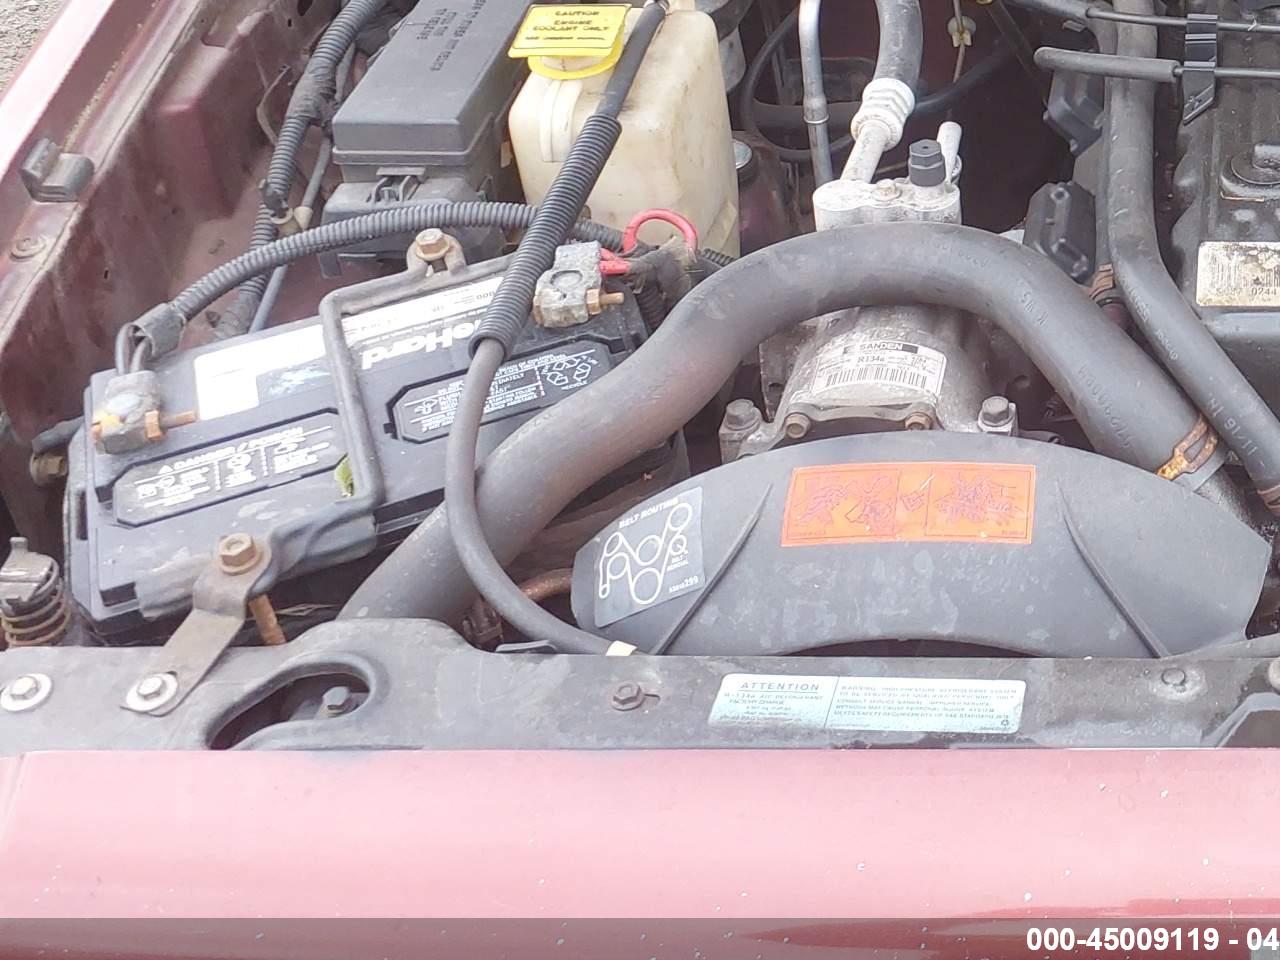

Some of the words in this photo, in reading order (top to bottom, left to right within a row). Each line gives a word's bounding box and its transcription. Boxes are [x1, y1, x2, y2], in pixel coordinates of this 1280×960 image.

[860, 342, 902, 350] SANDEN
[858, 355, 885, 363] R134a
[619, 514, 640, 529] BELT
[640, 497, 680, 520] ROUTING
[741, 681, 819, 691] ATTENTION
